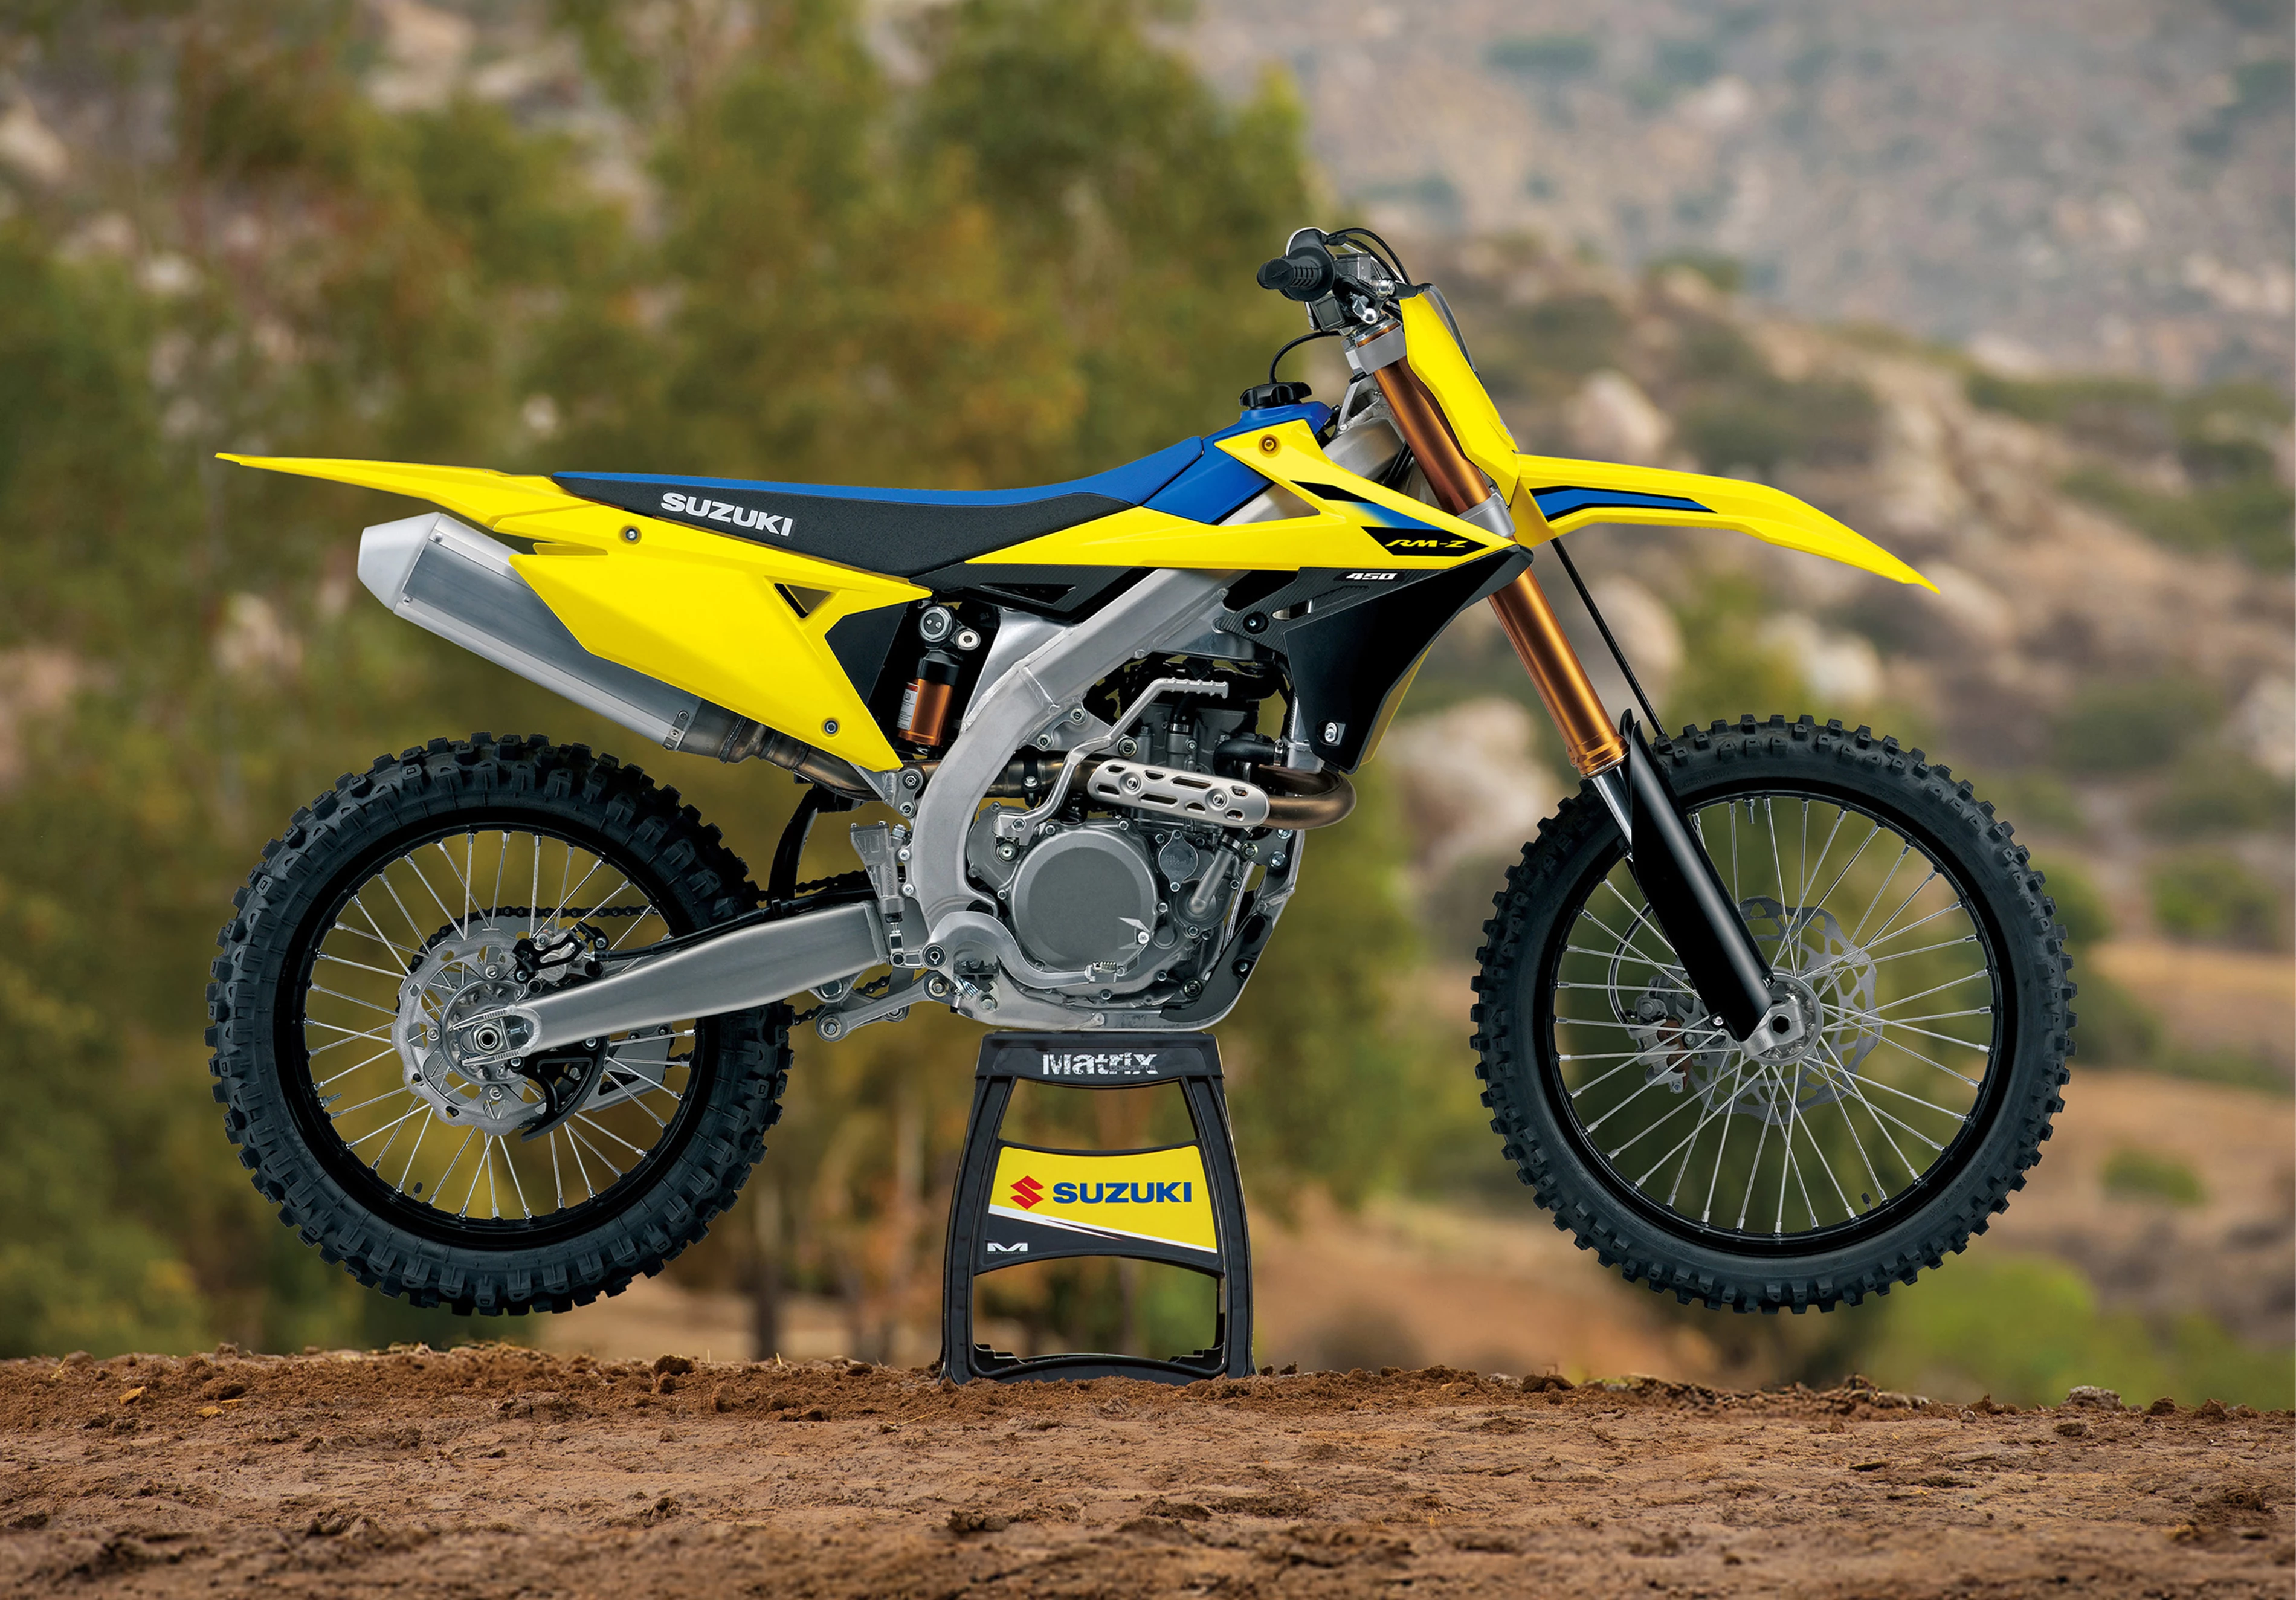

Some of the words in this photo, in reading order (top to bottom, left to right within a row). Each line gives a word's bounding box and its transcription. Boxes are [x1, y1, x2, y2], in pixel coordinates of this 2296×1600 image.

[660, 492, 793, 537] SUZUKI
[1385, 539, 1468, 548] RM-Z
[1042, 1052, 1158, 1074] Matrix
[1053, 1182, 1192, 1204] SUZUKI
